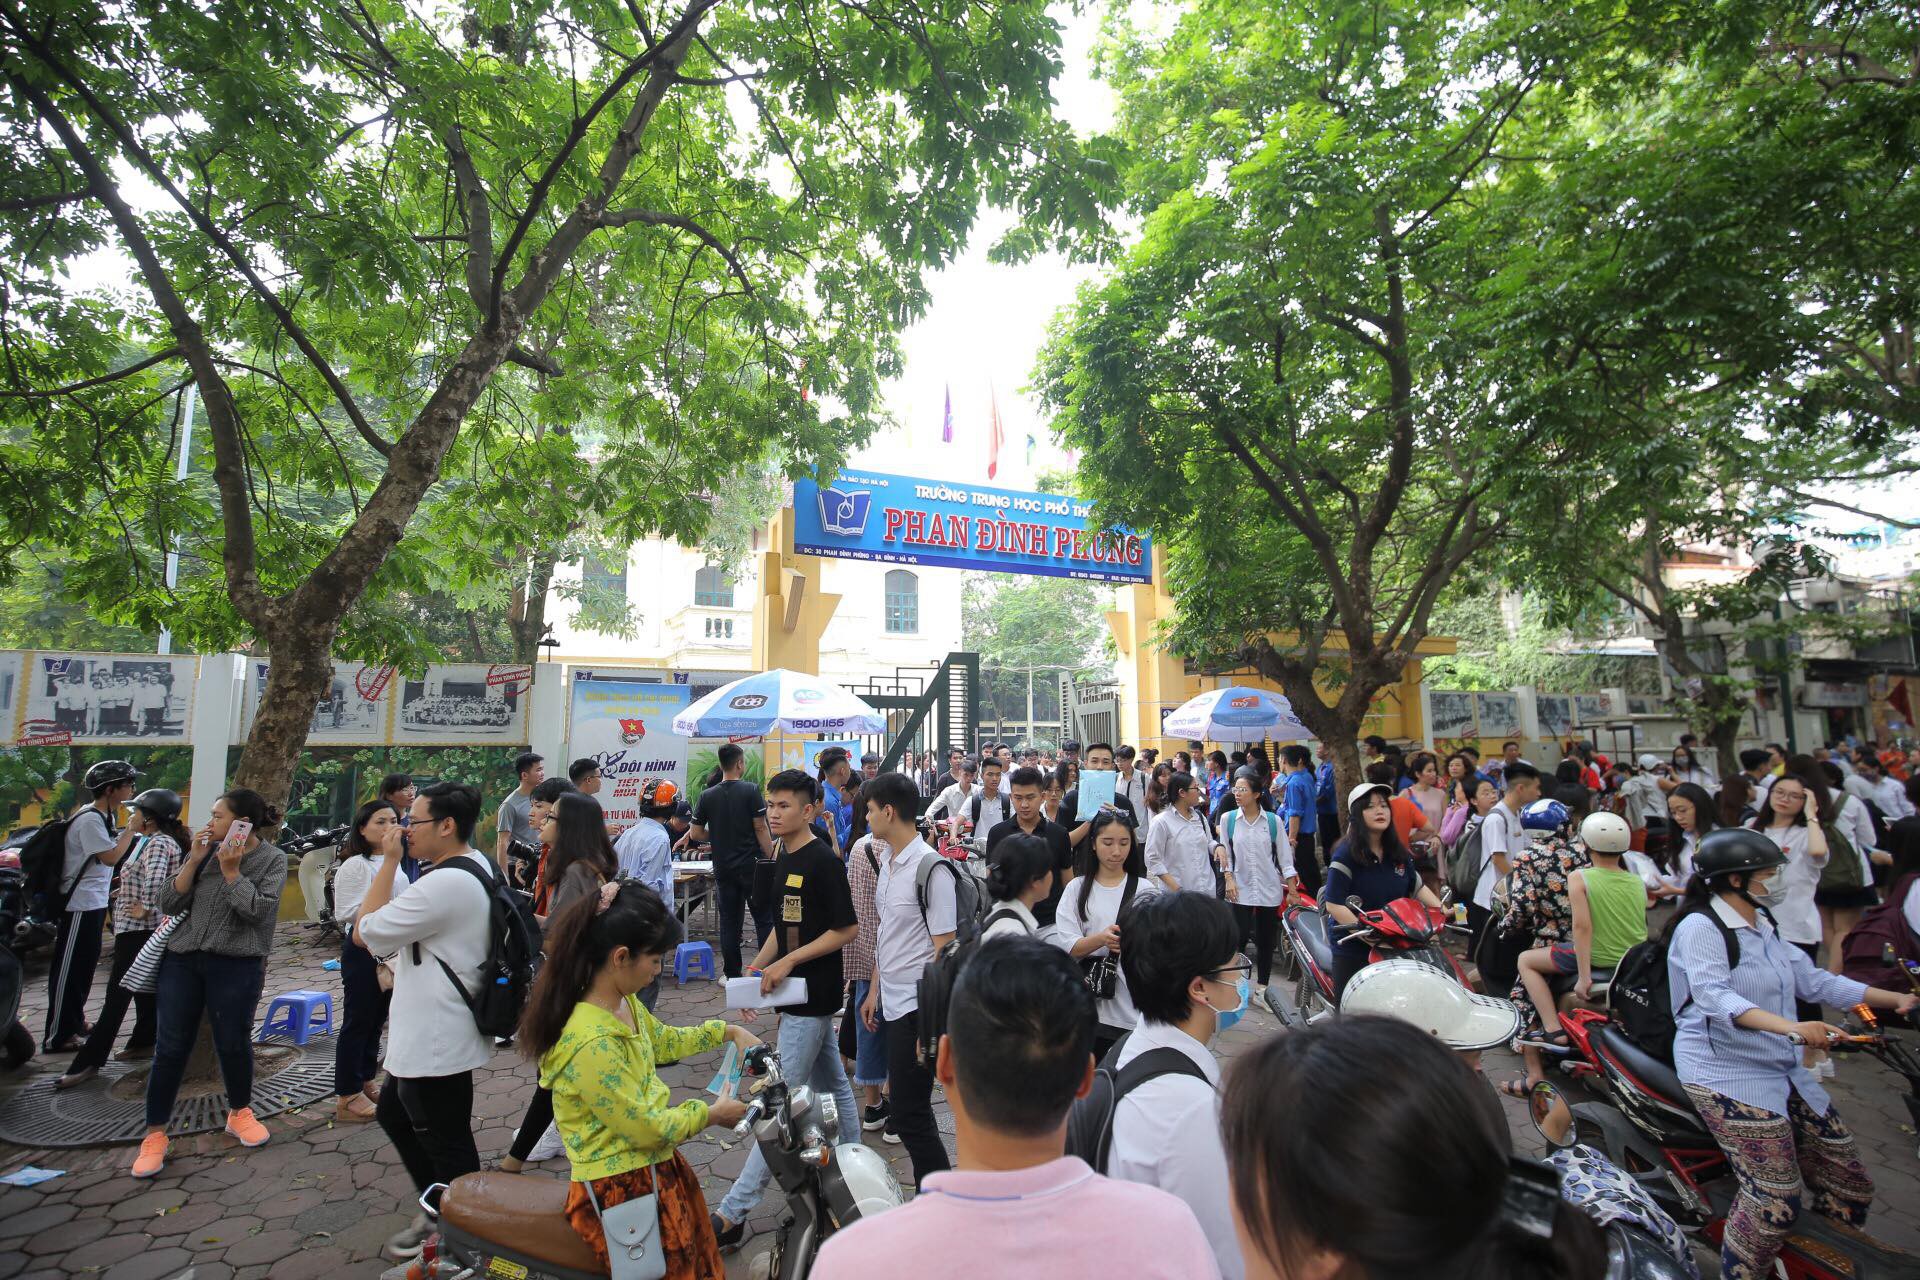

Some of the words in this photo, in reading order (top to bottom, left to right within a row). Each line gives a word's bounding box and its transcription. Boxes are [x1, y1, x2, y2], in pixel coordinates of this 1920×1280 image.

[914, 483, 968, 503] TRƯỜNG
[971, 492, 1010, 509] TRUNG
[1014, 498, 1041, 514] HỌC
[884, 507, 970, 549] PHAN
[975, 508, 1050, 556] ĐÌNH
[792, 719, 820, 729] 1800
[822, 718, 845, 728] 1166
[618, 760, 642, 775] ĐỘI
[644, 759, 677, 772] HÌNH
[617, 776, 640, 787] TIẾP
[785, 898, 800, 906] NOT
